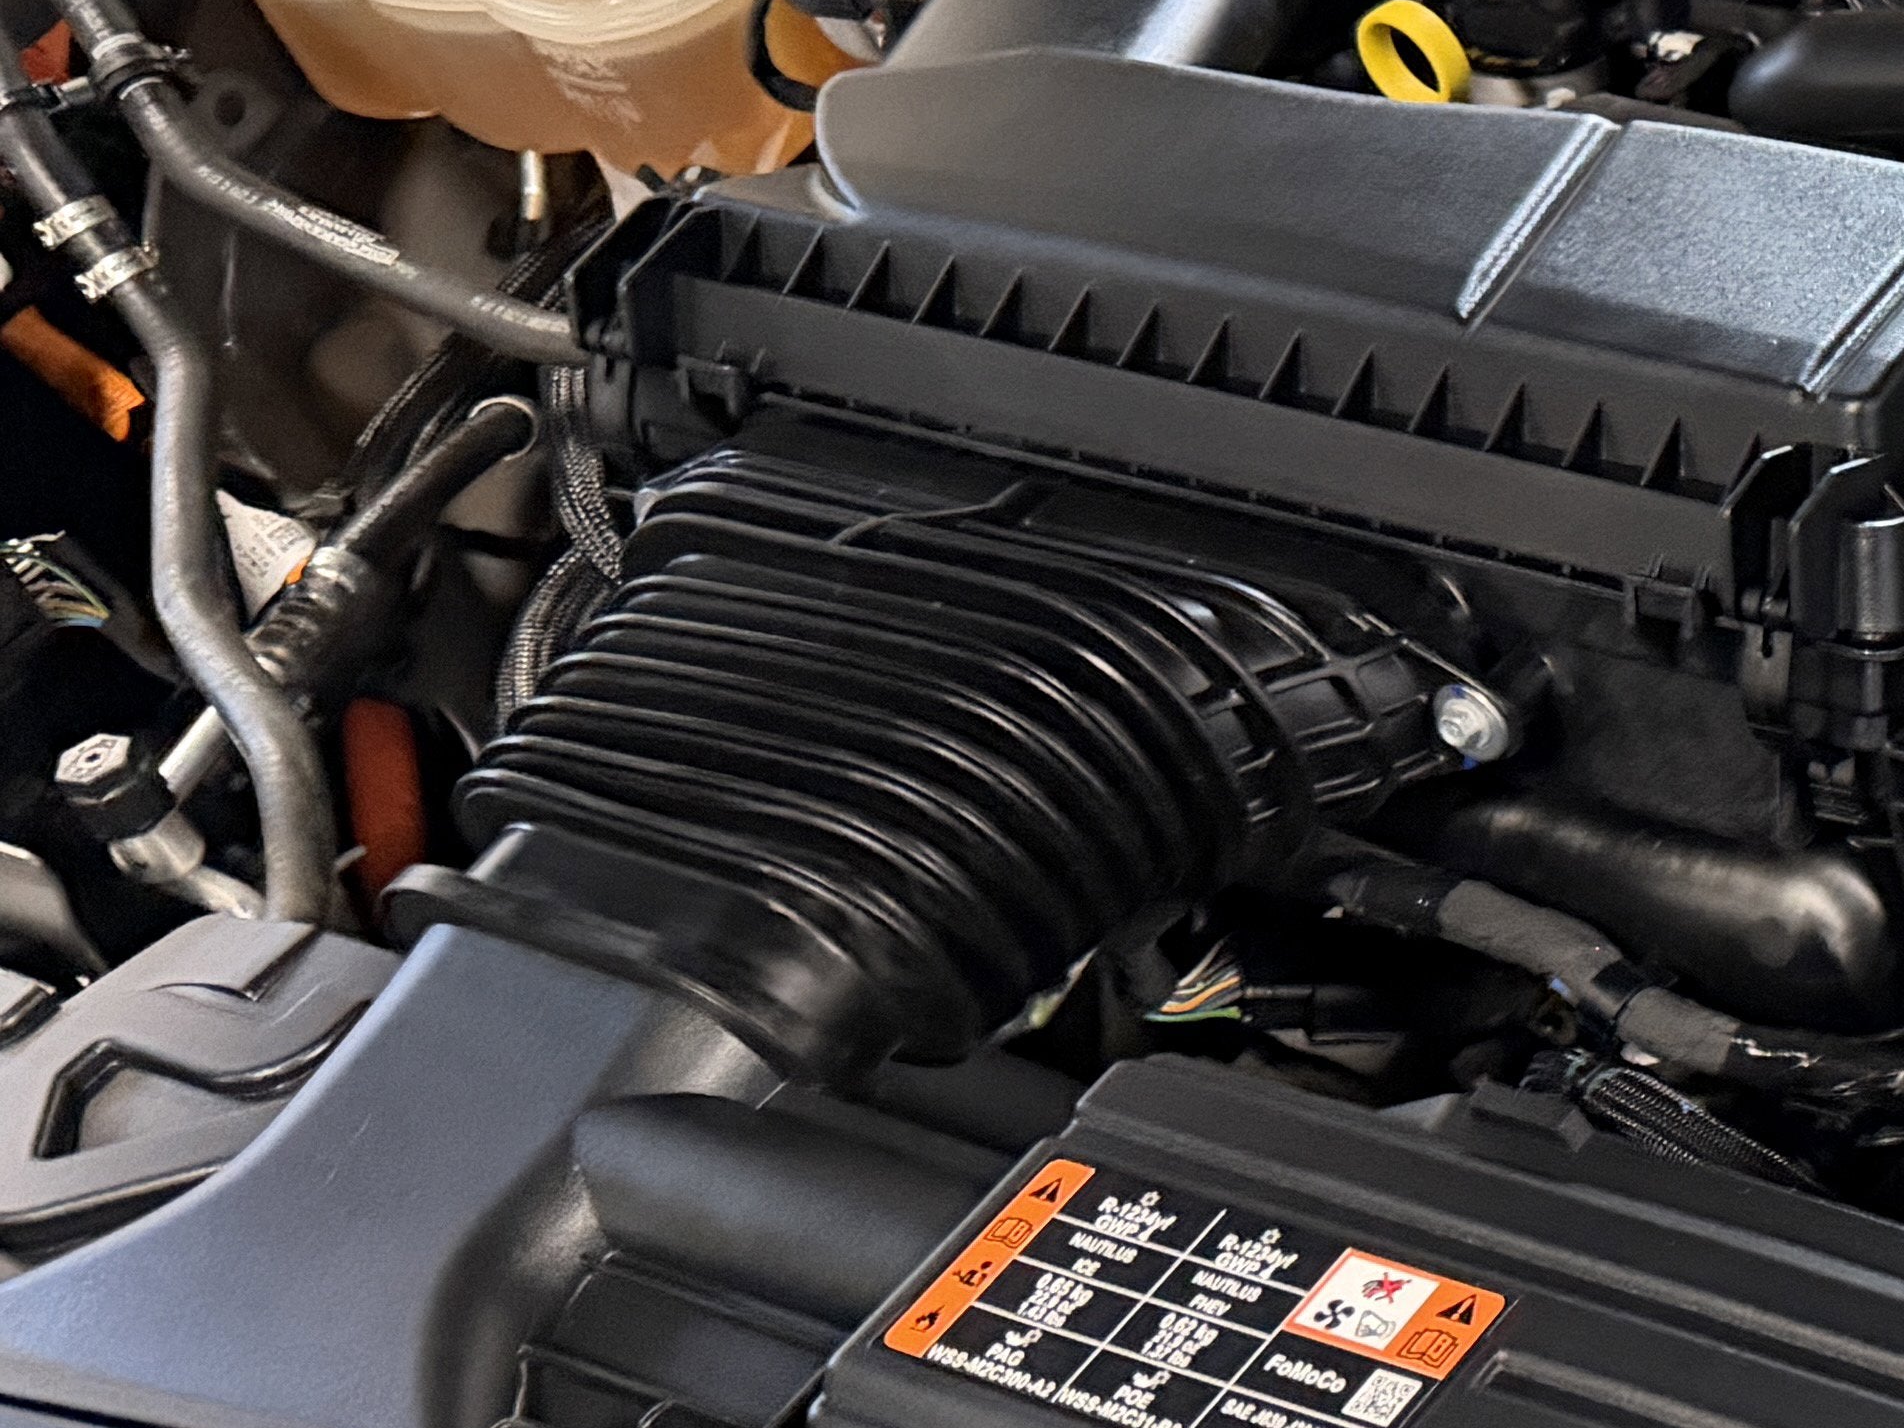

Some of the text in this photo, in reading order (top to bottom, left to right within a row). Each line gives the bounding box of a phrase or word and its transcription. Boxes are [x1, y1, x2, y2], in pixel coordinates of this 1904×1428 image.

[1095, 1214, 1141, 1237] GWP
[1097, 1196, 1178, 1232] R-1234yf
[1068, 1231, 1139, 1264] NAUTILUS
[1214, 1252, 1261, 1275] GWP
[1217, 1232, 1299, 1269] R-1234yf
[1071, 1257, 1101, 1277] ICE
[1035, 1273, 1094, 1308] 0.65 kg
[1191, 1270, 1263, 1303] NAUTILUS
[1188, 1293, 1232, 1317] FHEV
[1158, 1312, 1219, 1348] 0.62 kg
[926, 1342, 1057, 1400] WSS-M2C300-A2
[984, 1342, 1026, 1367] PAG
[1263, 1352, 1347, 1394] FoMoCo
[1112, 1383, 1157, 1411] POE
[1220, 1398, 1257, 1421] SAE
